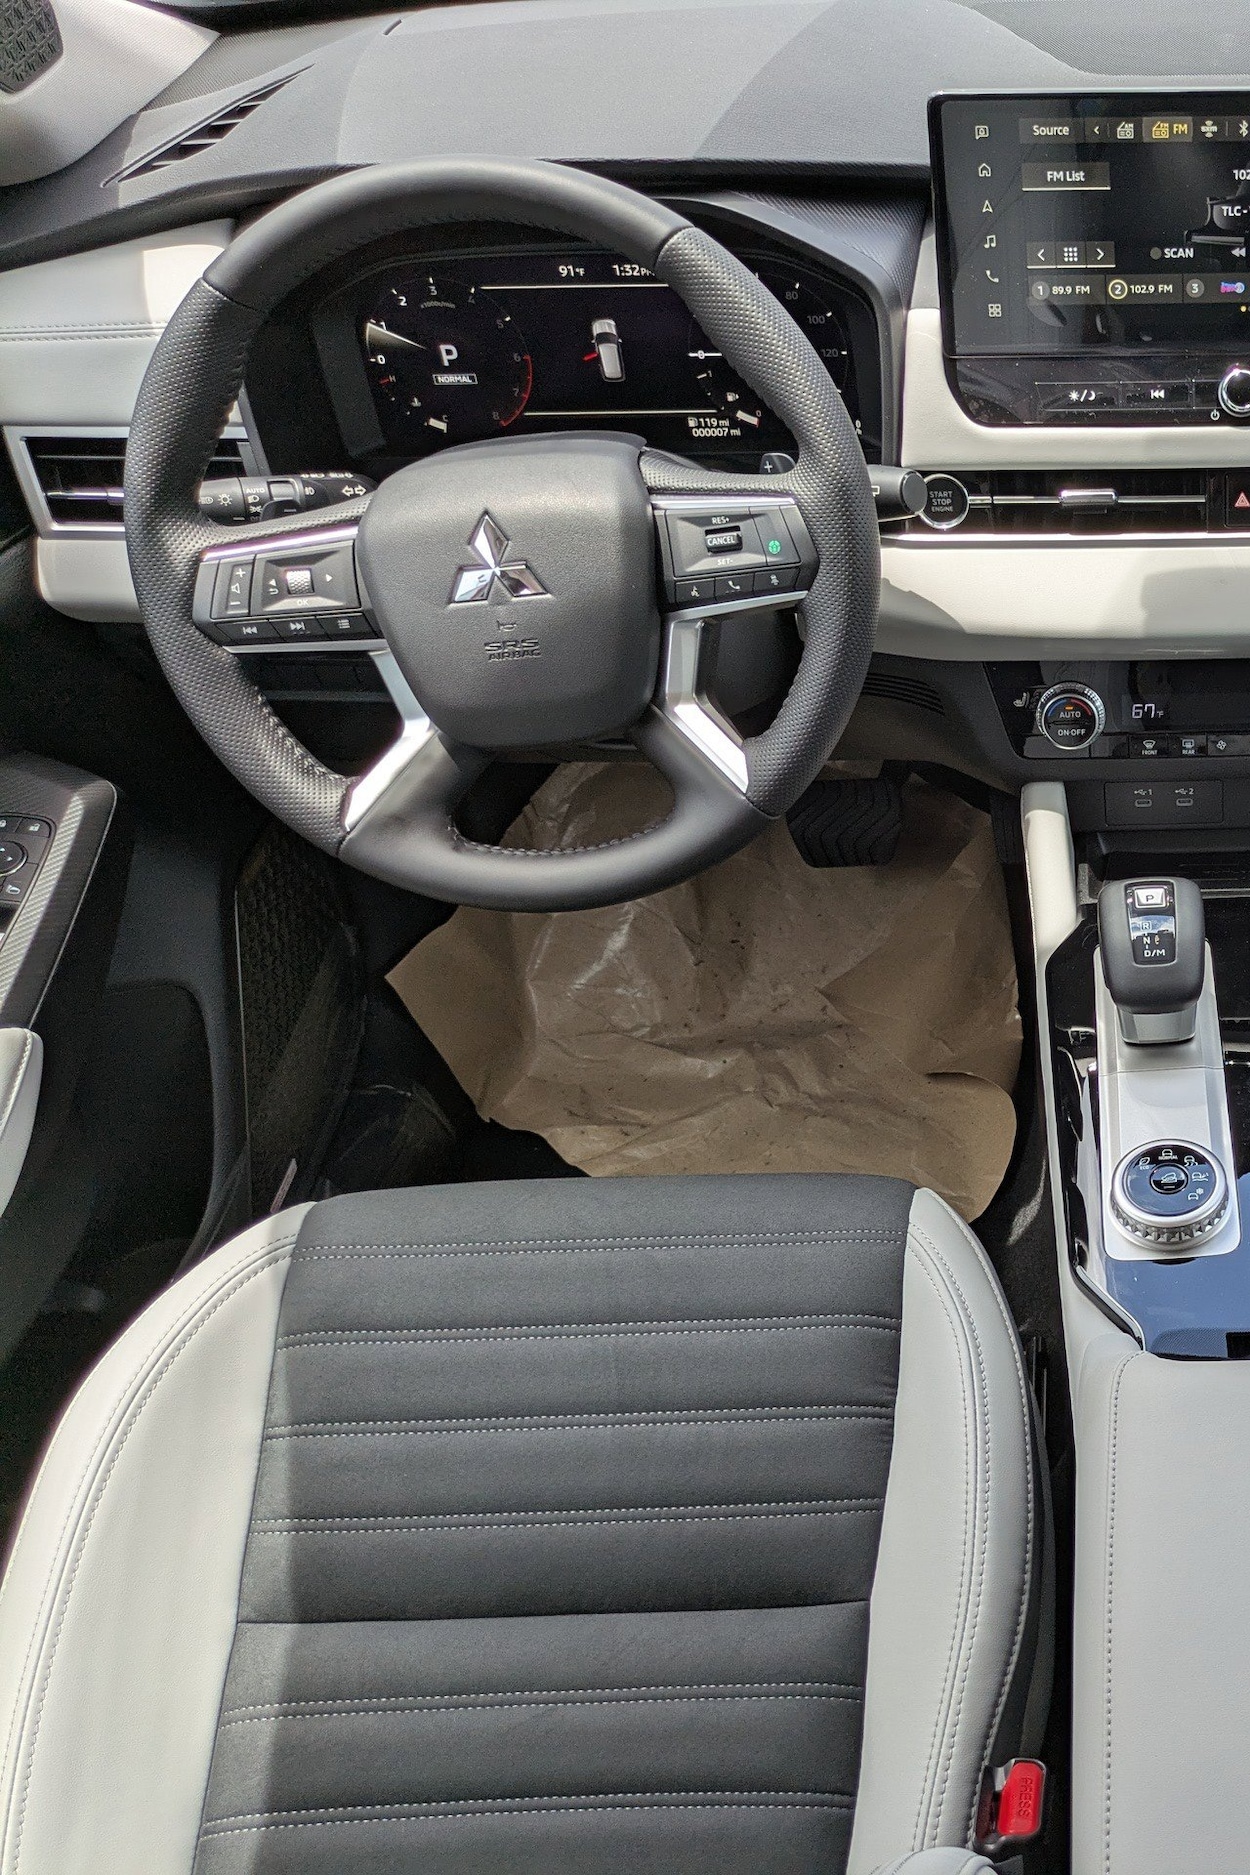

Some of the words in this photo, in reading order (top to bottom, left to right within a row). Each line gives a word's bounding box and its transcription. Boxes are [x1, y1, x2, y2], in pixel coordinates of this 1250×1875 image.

[1032, 125, 1070, 137] Source
[1172, 123, 1188, 135] FM
[1046, 170, 1065, 182] FM
[1066, 170, 1085, 182] List
[1221, 205, 1241, 217] TLC
[1163, 248, 1194, 259] SCAN
[428, 285, 438, 296] 3
[1051, 285, 1072, 295] 89.9
[1075, 285, 1091, 295] FM
[1130, 284, 1155, 294] 102.9
[1158, 284, 1173, 294] FM
[398, 295, 408, 307] 2
[376, 354, 386, 365] 0
[438, 343, 459, 367] P
[437, 375, 473, 384] NORMAL
[699, 418, 718, 427] 119
[718, 418, 730, 427] mi
[691, 427, 729, 437] 000007
[730, 427, 741, 436] mi
[245, 486, 266, 494] AUTO
[928, 490, 954, 498] START
[931, 498, 952, 506] STOP
[706, 536, 736, 546] CANCEL
[484, 637, 540, 654] SRS
[1058, 711, 1082, 719] AUTO
[1145, 894, 1155, 903] P
[1142, 922, 1150, 930] R
[1143, 936, 1151, 945] N
[1143, 949, 1166, 958] D/M
